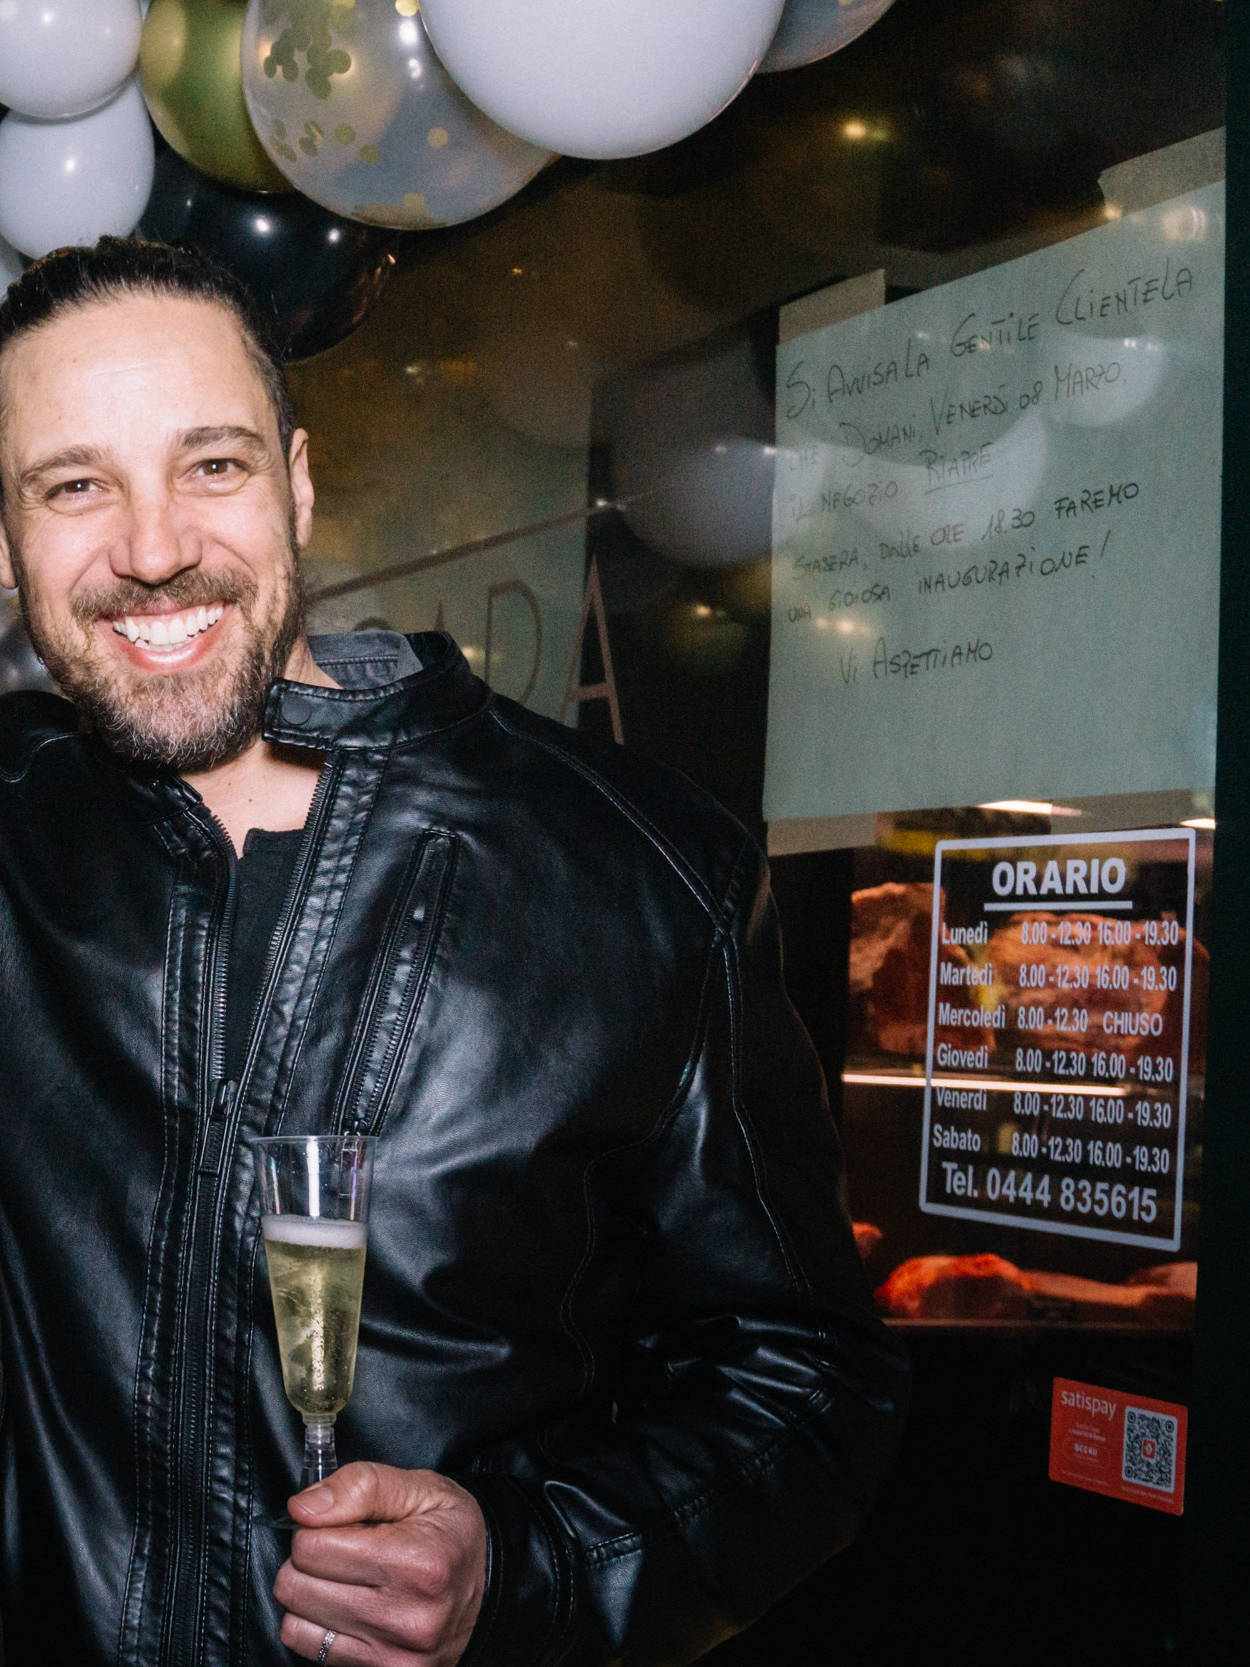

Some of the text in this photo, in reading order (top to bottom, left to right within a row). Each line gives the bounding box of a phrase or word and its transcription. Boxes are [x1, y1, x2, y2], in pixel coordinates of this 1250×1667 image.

[1019, 380, 1043, 410] 08
[930, 522, 965, 547] ORE
[981, 508, 1035, 542] 18.30
[1054, 482, 1140, 520] FAREMO
[992, 857, 1127, 896] ORARIO
[941, 921, 988, 945] Lunedì
[1021, 921, 1047, 944] 8.00
[1098, 921, 1131, 945] 16.00
[940, 962, 993, 986] Martedì
[1019, 964, 1045, 988] 8.00
[1096, 965, 1129, 990] 16.00
[938, 1002, 1006, 1029] Mercoledì
[1017, 1007, 1044, 1030] 8.00
[1103, 1011, 1163, 1036] CHIUSO
[937, 1043, 988, 1069] Giovedì
[1015, 1048, 1042, 1073] 8.00
[1091, 1051, 1126, 1079] 16.00
[936, 1086, 987, 1111] Venerdì
[1014, 1092, 1040, 1116] 8.00
[1089, 1096, 1124, 1124] 16.00
[933, 1123, 981, 1152] Sabato
[1012, 1132, 1038, 1158] 8.00
[1087, 1140, 1122, 1169] 16.00
[941, 1161, 1157, 1223] Tel. 0444 835615
[1061, 1389, 1117, 1421] satispay
